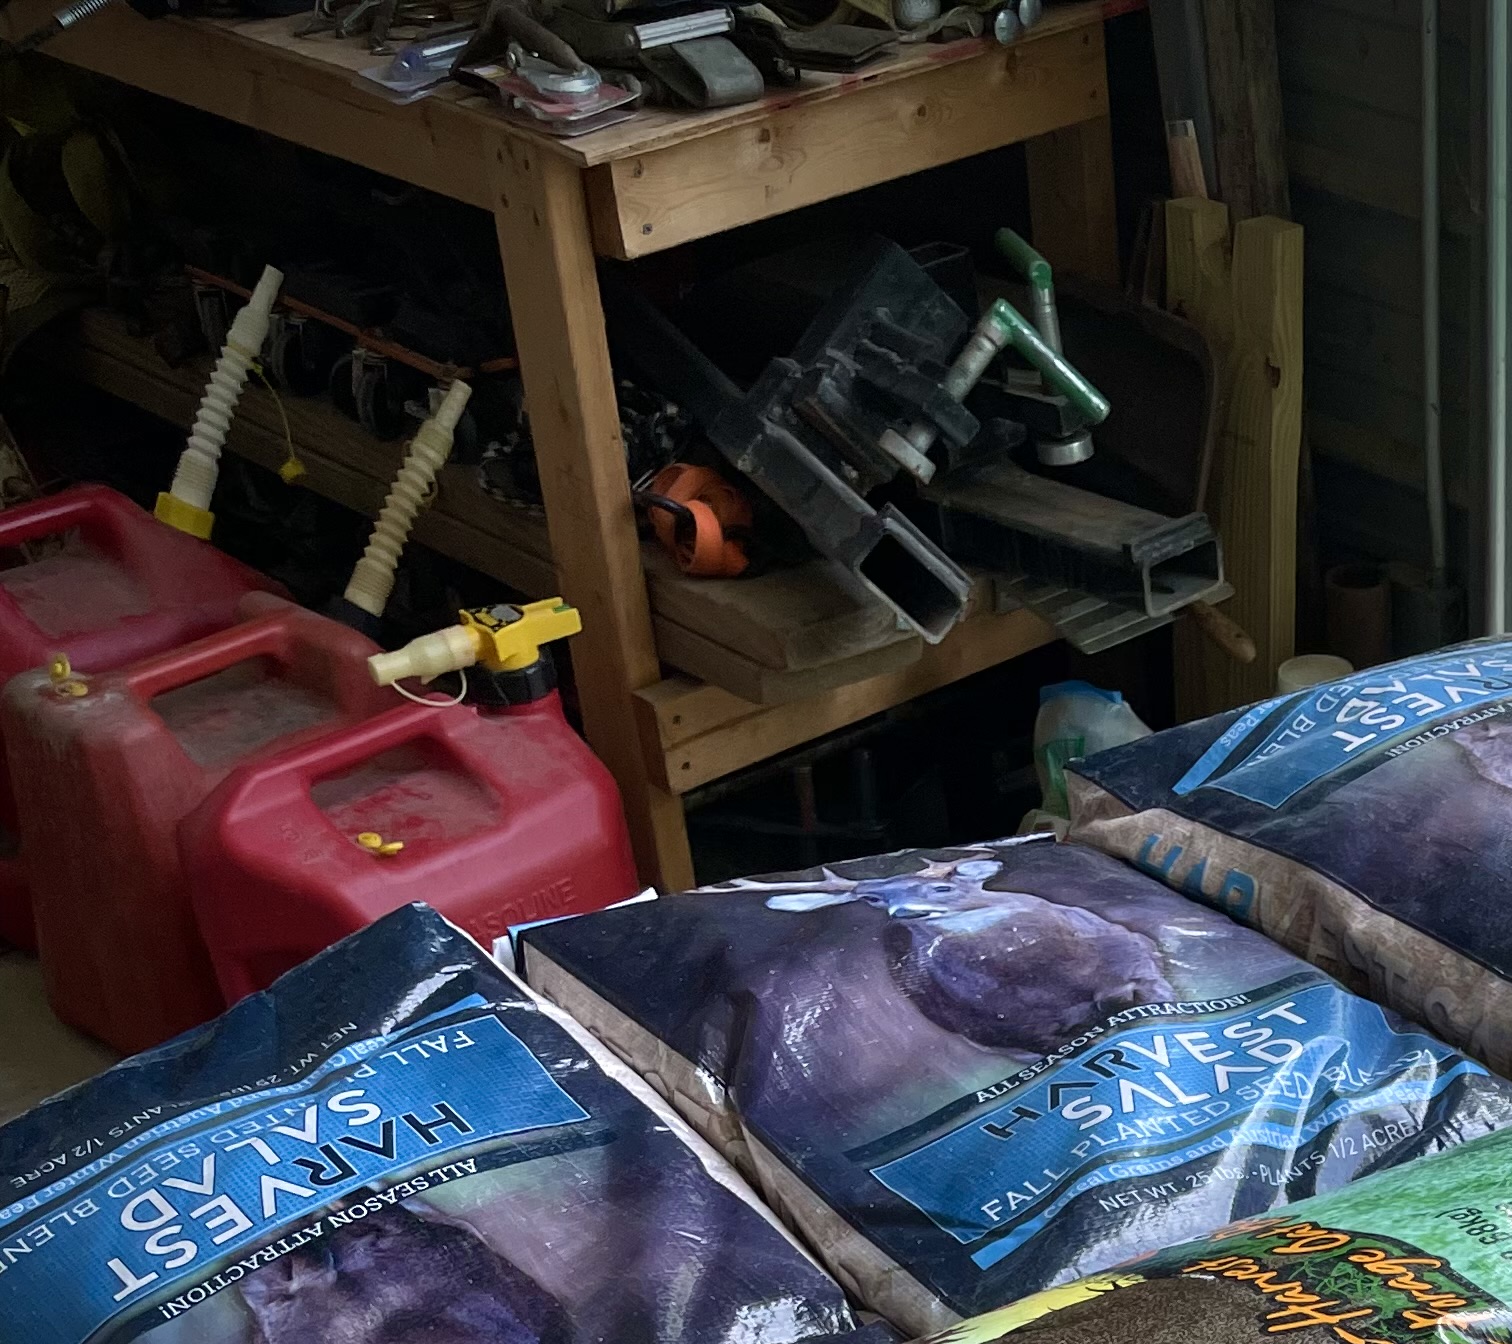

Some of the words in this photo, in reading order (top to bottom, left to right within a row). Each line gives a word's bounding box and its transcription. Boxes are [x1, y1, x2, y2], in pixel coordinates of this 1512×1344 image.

[379, 1030, 476, 1067] FALL
[976, 1079, 1021, 1104] ALL
[1022, 1025, 1106, 1082] SEASON
[1106, 993, 1254, 1028] ATTRACTION!
[980, 1000, 1309, 1141] HARVEST
[1060, 1035, 1307, 1132] SALAD
[9, 1154, 67, 1190] ACRE
[43, 1150, 122, 1194] Winter
[106, 1142, 202, 1199] SEED
[118, 1088, 382, 1232] SALAD
[428, 1156, 477, 1185] ALL
[980, 1165, 1071, 1222] FALL
[1071, 1099, 1232, 1159] PLANTED
[1235, 1069, 1313, 1101] SEED
[1098, 1188, 1143, 1213] NET
[1143, 1180, 1186, 1203] WT.
[1328, 1135, 1360, 1161] 1/2
[1362, 1118, 1419, 1152] ACRE
[1108, 1150, 1186, 1180] Grains
[1186, 1134, 1229, 1162] and
[1305, 1094, 1381, 1134] Winter
[0, 1193, 42, 1220] Pea
[105, 1100, 475, 1301] HARVEST
[330, 1175, 430, 1229] SEASON
[160, 1221, 327, 1321] ATTRACTION!
